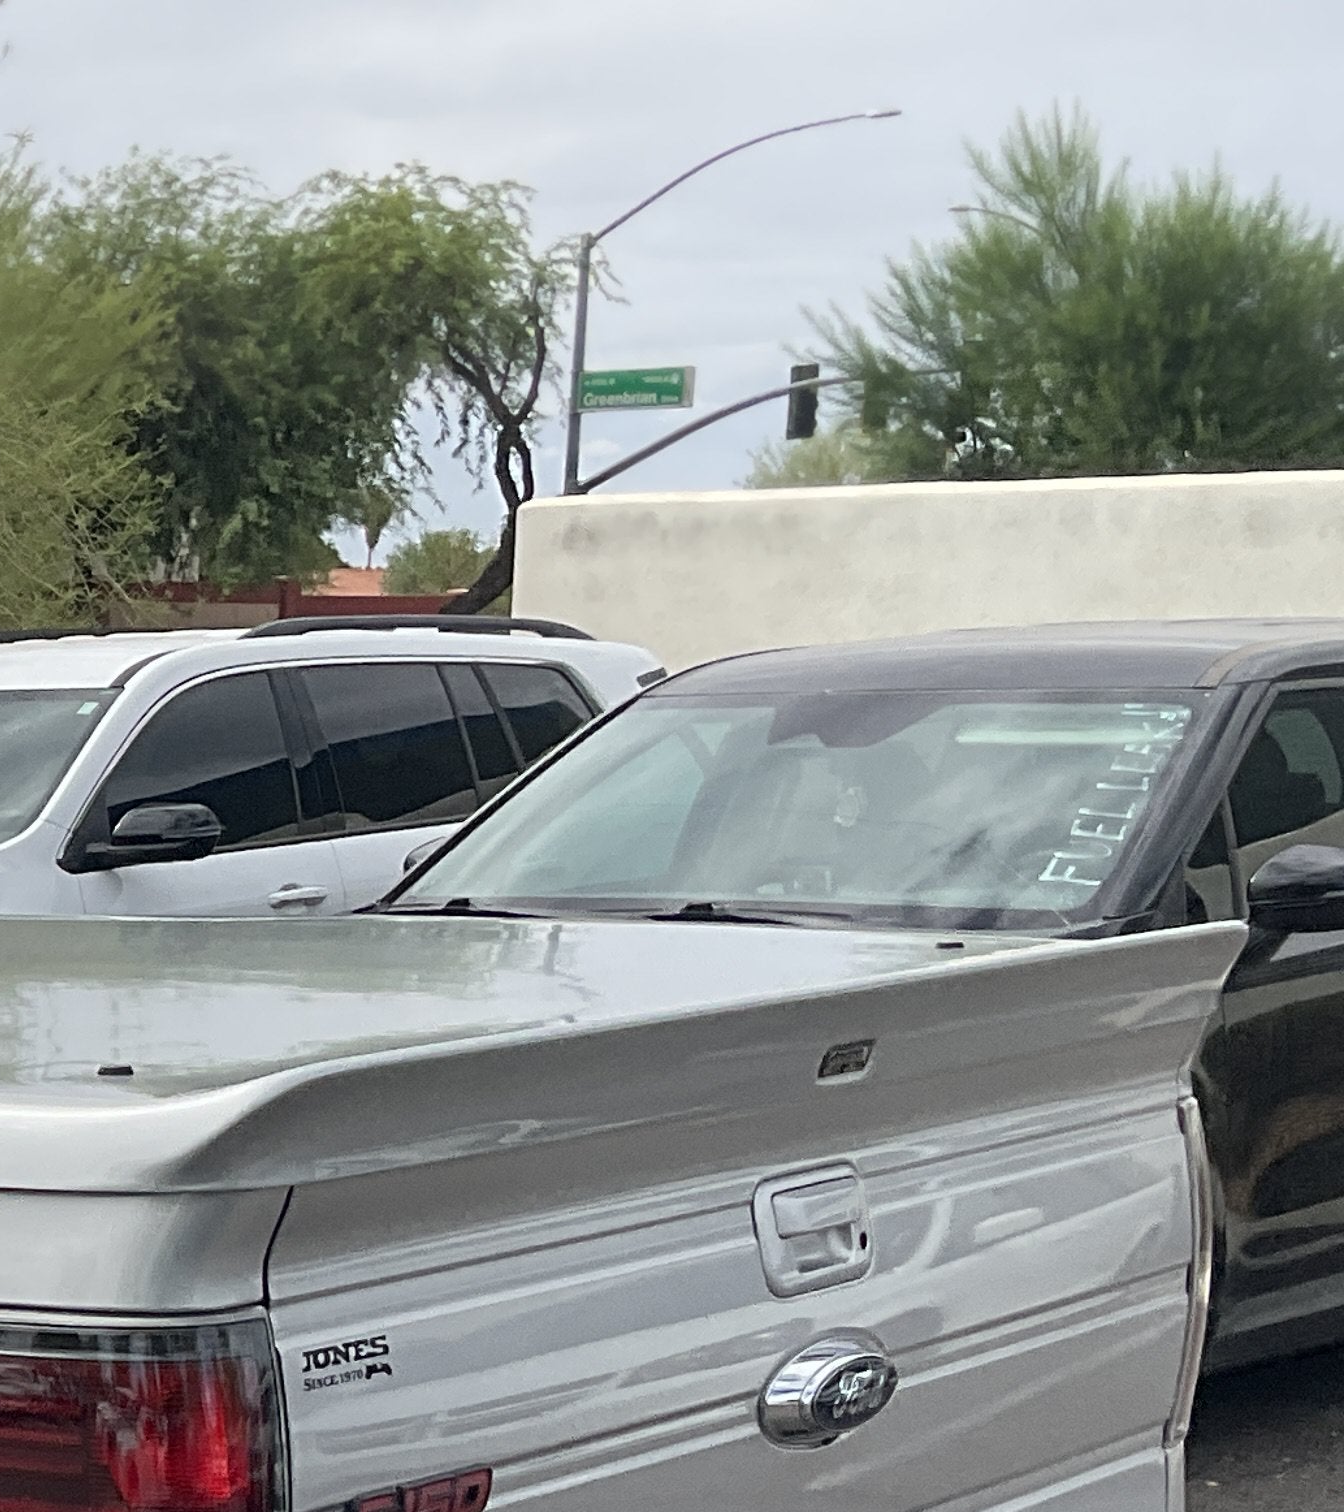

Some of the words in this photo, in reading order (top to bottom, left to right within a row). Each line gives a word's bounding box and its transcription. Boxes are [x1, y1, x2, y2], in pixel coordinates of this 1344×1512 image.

[1037, 802, 1136, 886] FUEL
[302, 1335, 389, 1373] JONES
[340, 1369, 364, 1384] 1970
